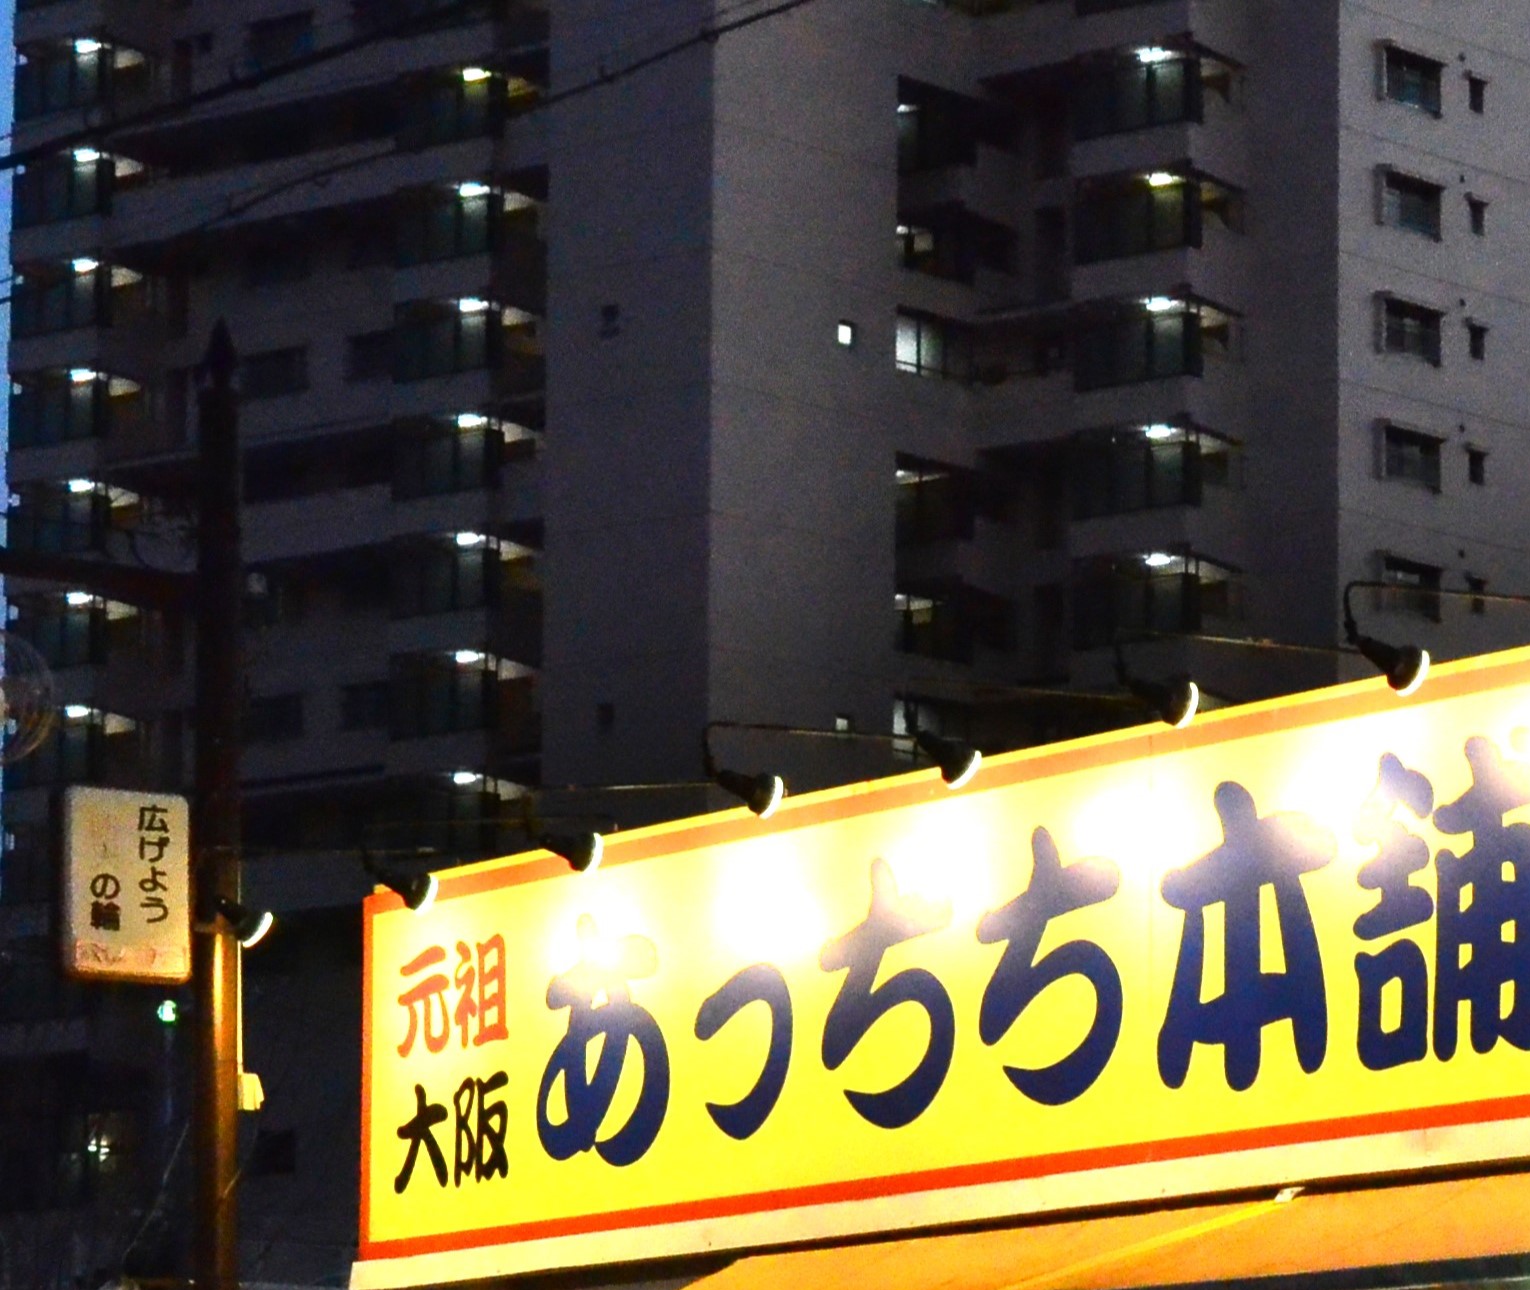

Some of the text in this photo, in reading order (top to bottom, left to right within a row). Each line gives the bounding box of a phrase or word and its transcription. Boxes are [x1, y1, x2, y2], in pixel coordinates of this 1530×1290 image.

[137, 804, 170, 924] 広げよう
[398, 933, 510, 1059] 元祖
[393, 1070, 510, 1195] 大阪
